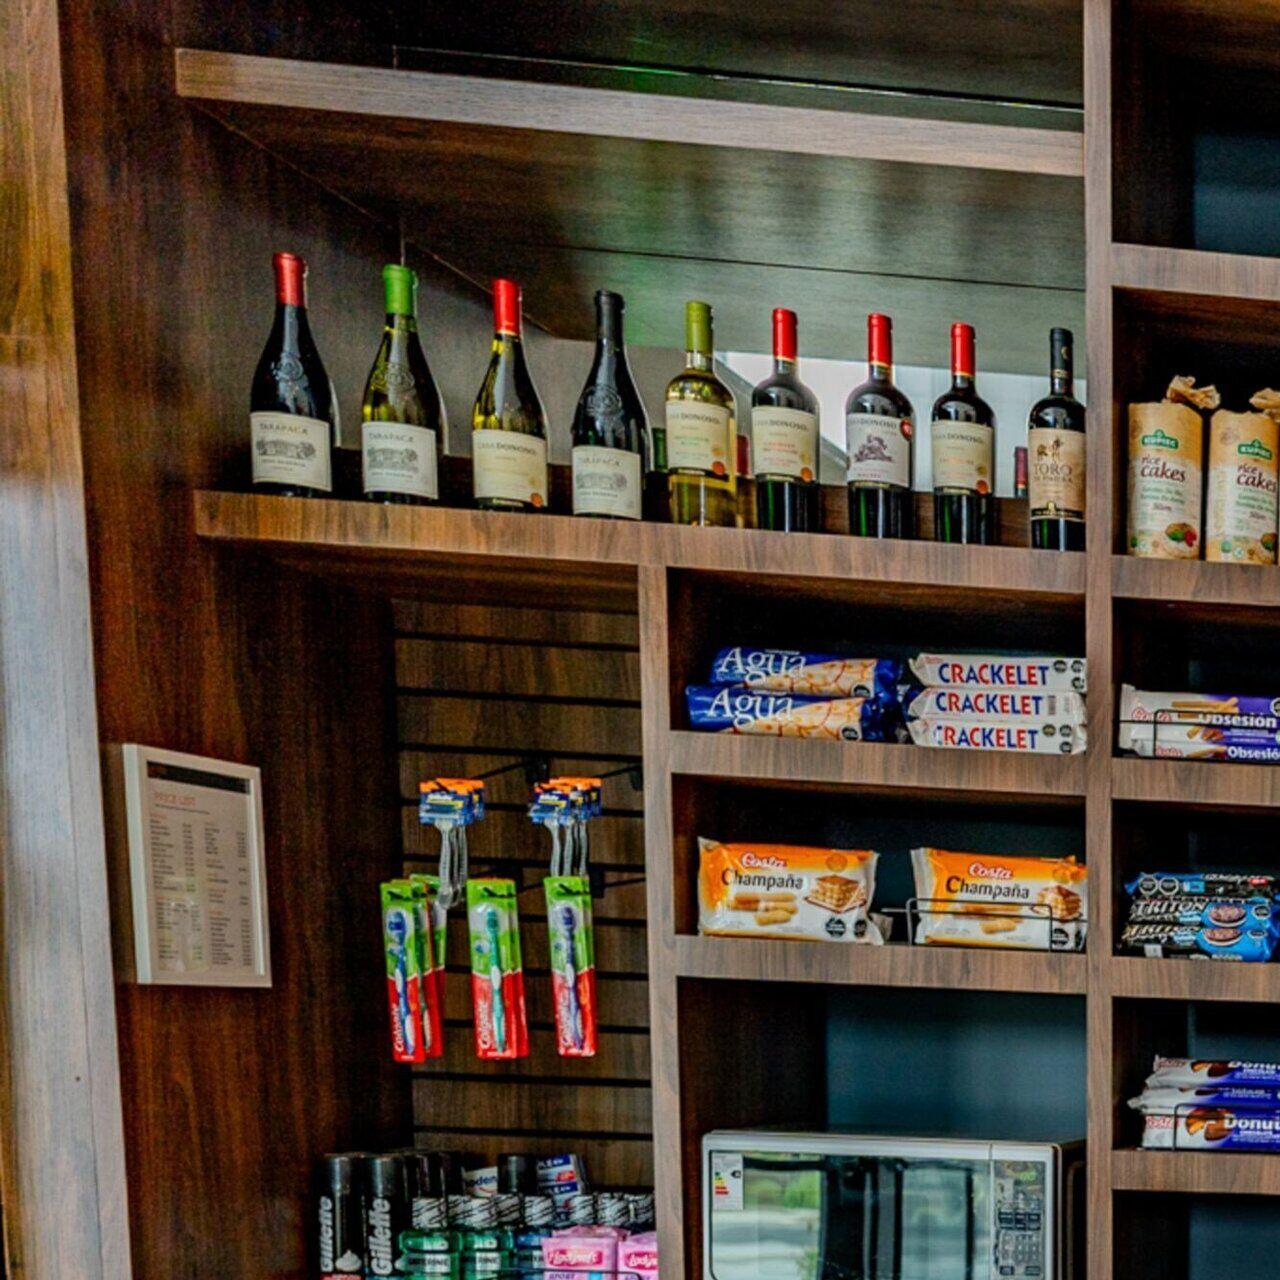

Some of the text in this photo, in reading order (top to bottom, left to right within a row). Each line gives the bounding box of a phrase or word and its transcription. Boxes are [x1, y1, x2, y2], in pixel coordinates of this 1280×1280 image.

[1141, 454, 1161, 464] rice
[1237, 464, 1258, 474] rice
[1033, 464, 1073, 476] TORO
[1140, 462, 1186, 482] cakes
[1237, 472, 1277, 492] cakes
[938, 663, 1049, 685] CRACKELET
[706, 688, 794, 728] Agua
[936, 692, 1043, 715] CRACKELET
[741, 852, 787, 869] Costa
[969, 862, 1013, 880] Costa
[721, 867, 803, 891] Champaña
[945, 875, 1030, 899] Champaña
[1135, 900, 1207, 913] TRITON
[478, 1000, 492, 1049] Colgate
[319, 1196, 333, 1272] Gillette
[368, 1198, 392, 1275] Gillette
